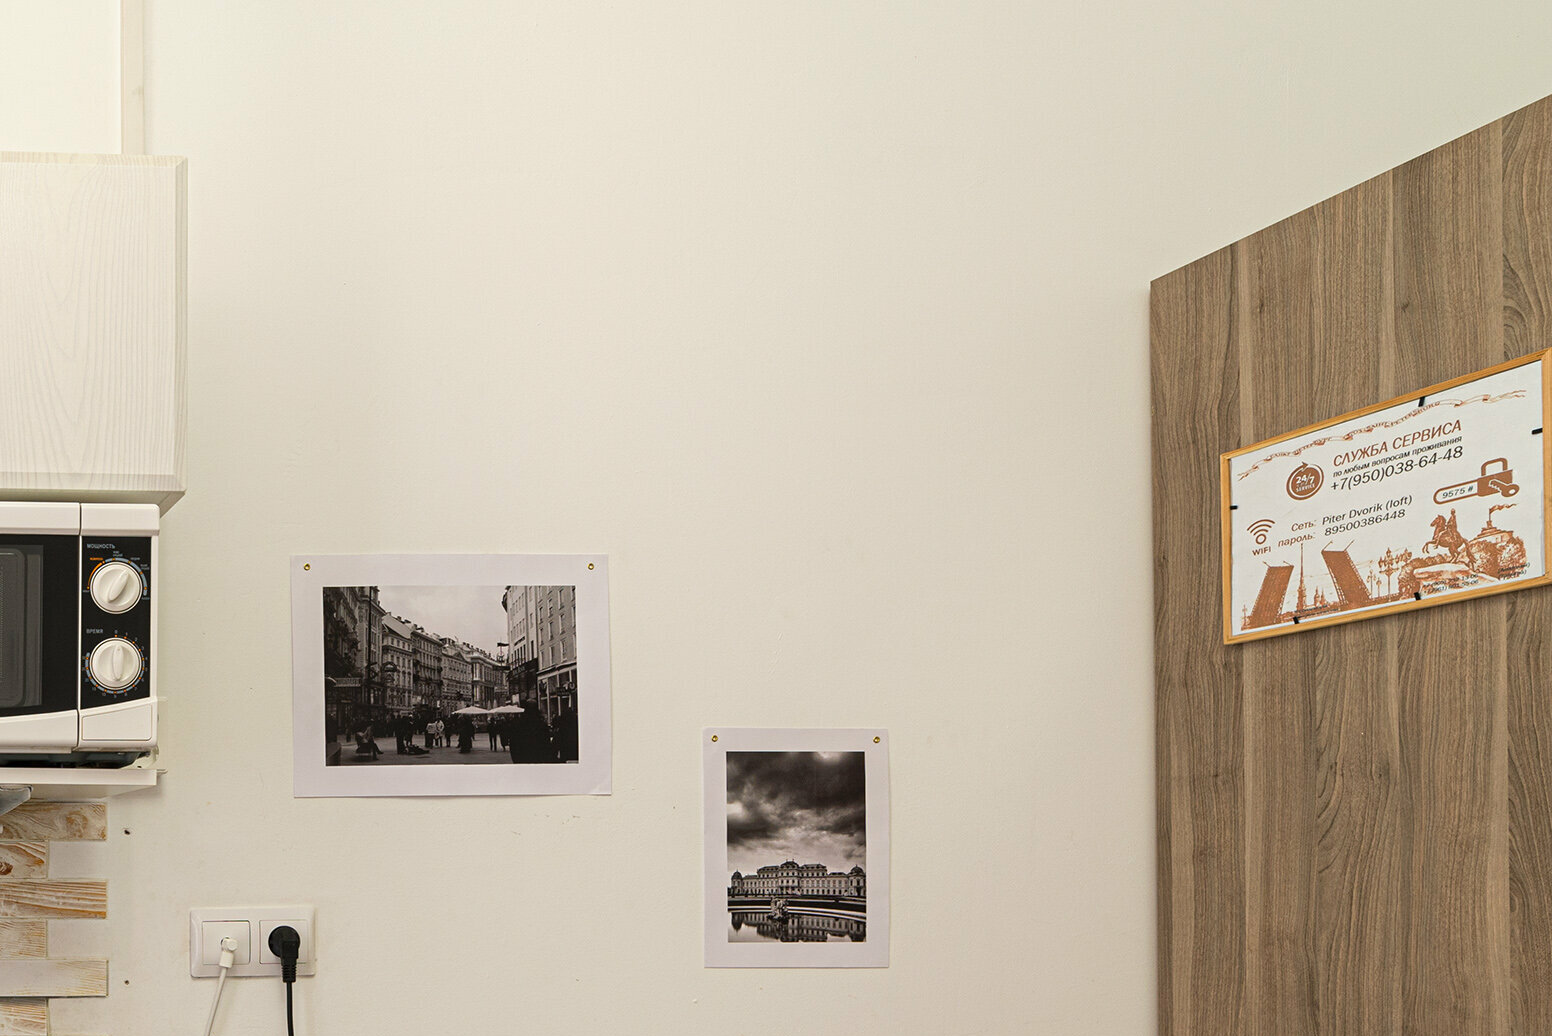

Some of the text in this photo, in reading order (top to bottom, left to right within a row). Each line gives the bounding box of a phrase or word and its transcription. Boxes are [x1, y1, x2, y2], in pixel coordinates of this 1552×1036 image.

[1333, 419, 1462, 467] СЛУЖБА СЕРВИСА
[1331, 445, 1463, 491] +7(950)038-64-48
[1333, 435, 1463, 478] по любым вопросам проживания
[1296, 473, 1315, 484] 24/7
[1442, 487, 1466, 499] 9575
[1322, 494, 1413, 526] Piter Dvorik (loft)
[1291, 519, 1317, 532] Сеть:
[1324, 508, 1406, 537] 89500386448
[1252, 546, 1272, 556] WIFI
[1277, 531, 1316, 548] пароль:
